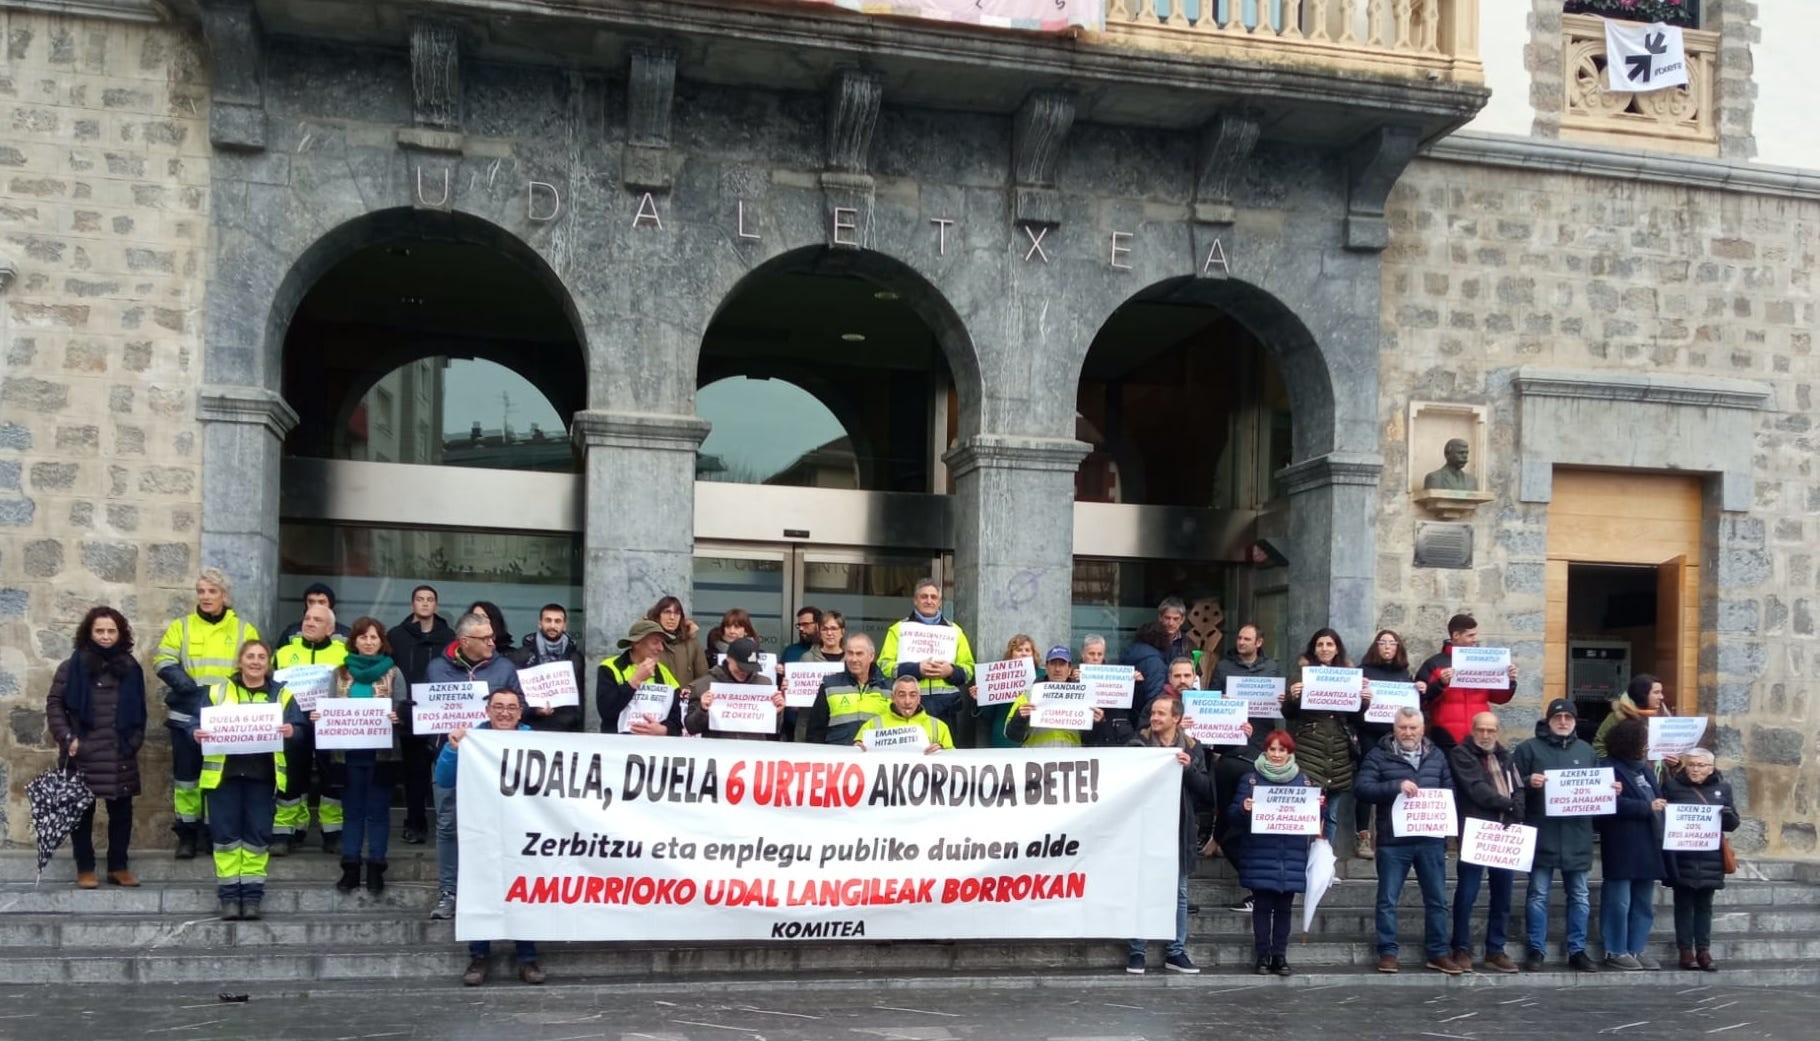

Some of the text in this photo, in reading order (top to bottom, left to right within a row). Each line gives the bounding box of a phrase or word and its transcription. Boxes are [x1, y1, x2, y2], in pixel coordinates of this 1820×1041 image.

[416, 165, 1230, 275] UDALETXEA
[989, 660, 1023, 671] LAN ETA
[985, 669, 1026, 682] ZERBITZU
[988, 680, 1026, 691] PUBLIKO
[429, 693, 475, 702] URTEETAN
[728, 694, 772, 702] BALDINTZA
[1065, 692, 1086, 700] BETE!
[441, 702, 463, 710] -20%
[323, 709, 352, 717] DUELA
[362, 708, 385, 717] URTE
[418, 712, 486, 721] EROS AHALMEN
[209, 715, 240, 724] DUELA
[251, 714, 276, 722] URTE
[326, 718, 382, 726] SINATUTAKO
[213, 723, 273, 733] SINATUTAKO
[431, 721, 474, 730] JAITSIERA
[317, 727, 391, 736] AKORDIOA BETE!
[875, 726, 917, 738] EMANDAKO
[874, 735, 919, 747] HITZA BETE!
[1560, 769, 1600, 778] AZKEN 10
[500, 748, 1099, 811] UDALA, DUELA 6 URTEKO AKORDIOA BETE!
[1560, 779, 1601, 787] URTEETAN
[1268, 787, 1295, 795] AZKEN
[1428, 790, 1443, 798] ETA
[1266, 796, 1307, 804] URTEETAN
[1572, 795, 1613, 804] AHALMEN
[1403, 801, 1447, 810] ZERBITZU
[1562, 805, 1602, 813] JAITSIERA
[1255, 813, 1317, 822] EROS AHALMEN
[1406, 812, 1447, 820] PUBLIKO
[1266, 823, 1305, 831] JAITSIERA
[1407, 823, 1448, 832] DUINAK!
[1481, 821, 1502, 830] LAN
[1475, 831, 1524, 845] ZERBITZU
[521, 832, 1080, 869] Zerbitzu eta enplegu publiko duinen alde
[1476, 842, 1521, 856] PUBLIKO
[1474, 852, 1520, 866] DUINAK!
[505, 872, 1086, 907] AMURRIOKO UDAL LANGILEAK BORROKAN
[771, 920, 866, 938] KOMITEA
